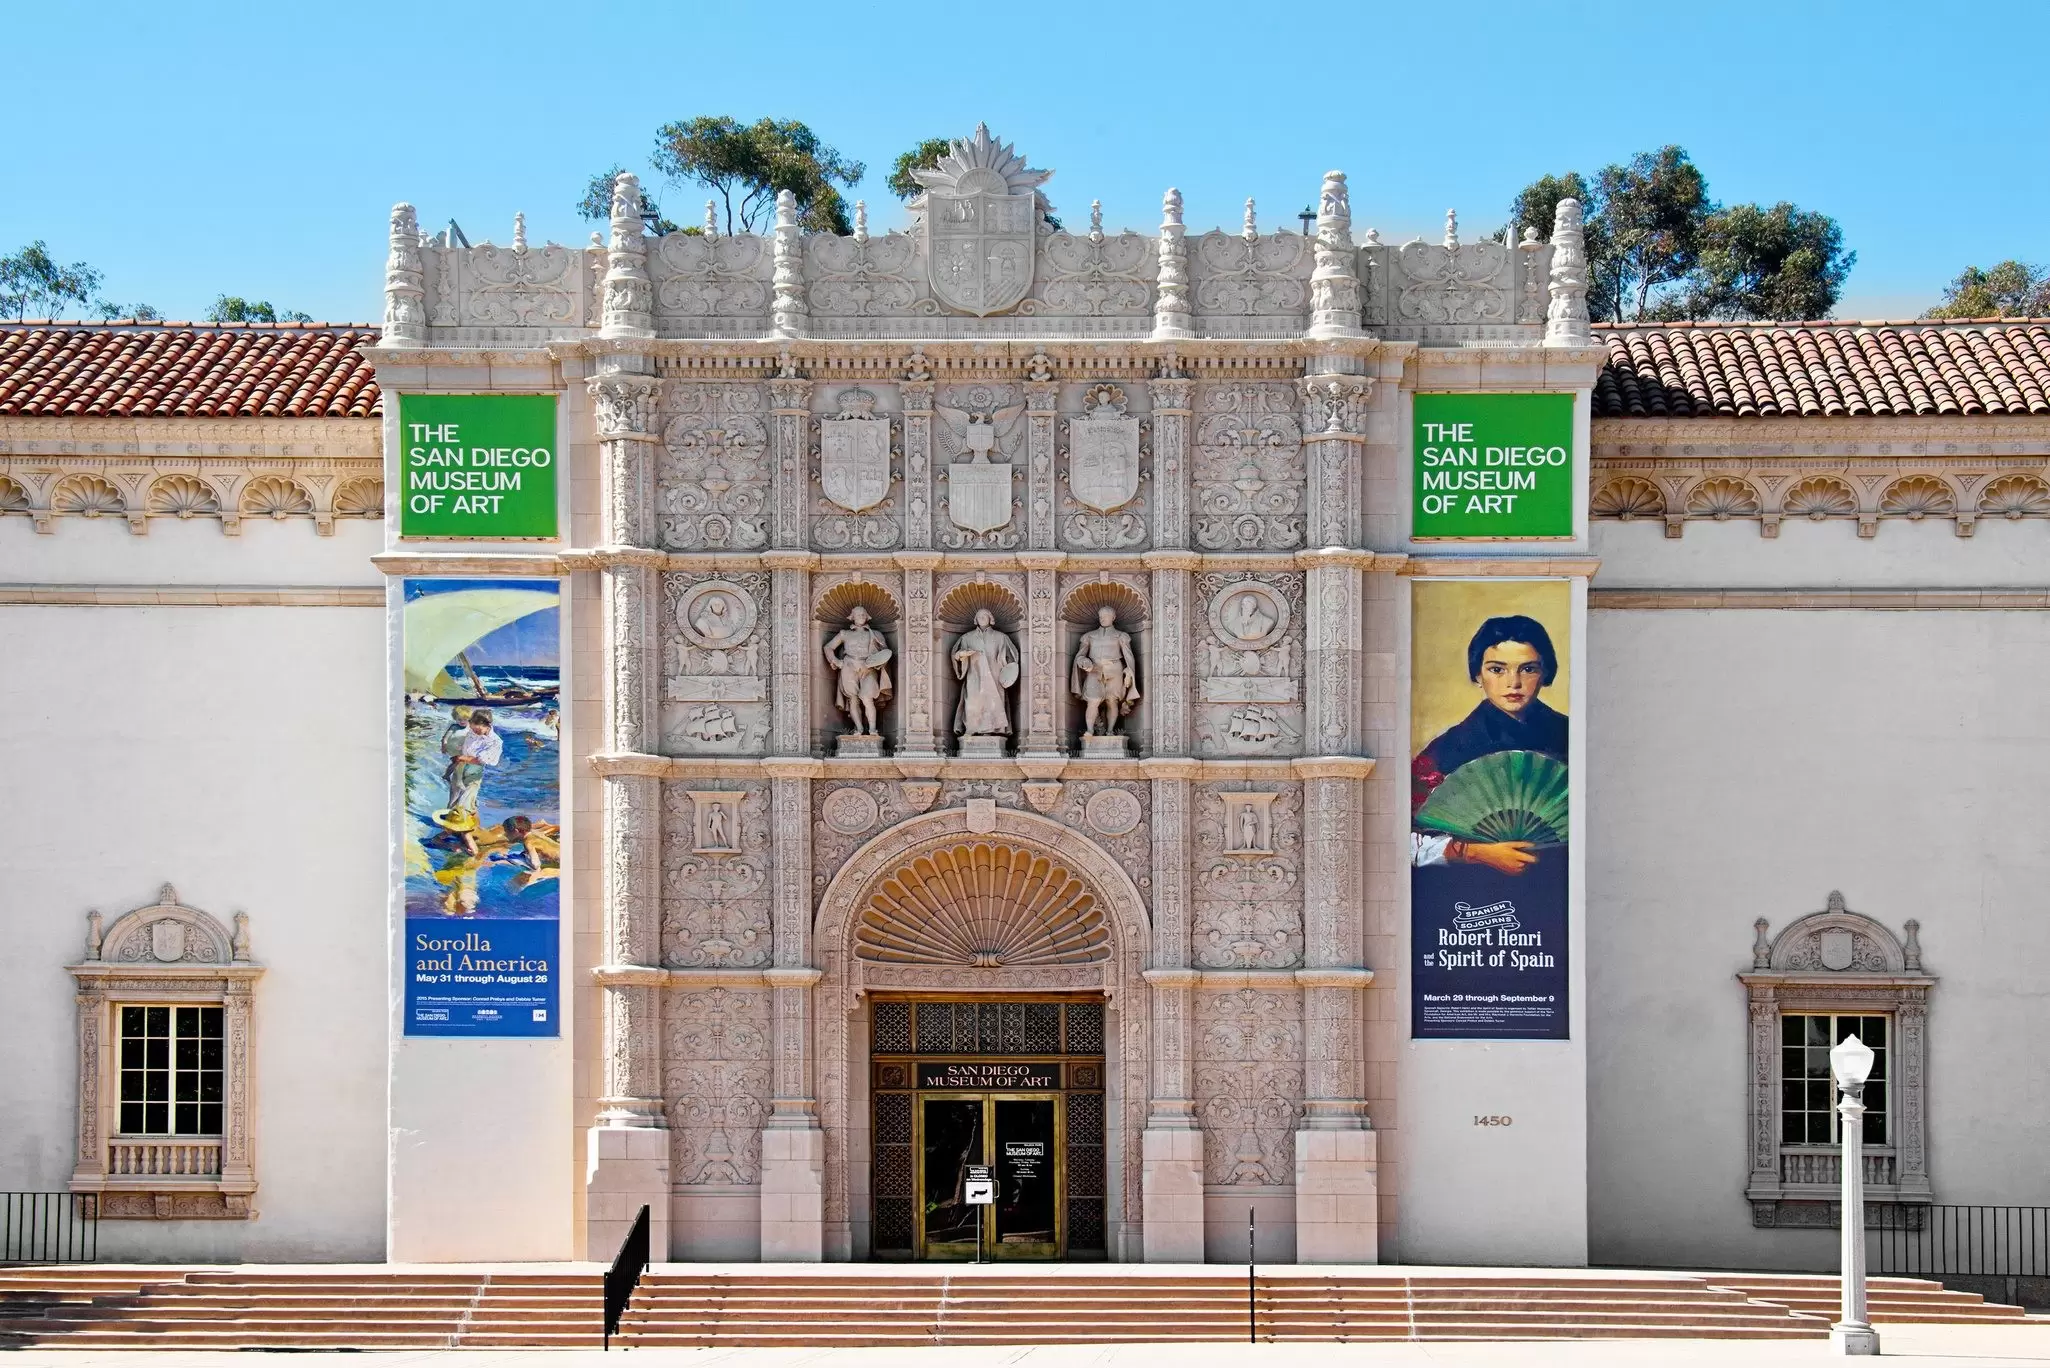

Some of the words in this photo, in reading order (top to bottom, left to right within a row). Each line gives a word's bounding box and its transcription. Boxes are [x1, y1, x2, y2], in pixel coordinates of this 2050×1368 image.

[409, 424, 460, 443] THE
[1422, 423, 1474, 443] THE
[410, 447, 464, 467] SAN
[472, 448, 551, 468] DIEGO
[1423, 447, 1478, 467] SAN
[1485, 446, 1567, 467] DIEGO
[410, 471, 521, 491] MUSEUM
[1423, 471, 1536, 491] MUSEUM
[410, 494, 446, 514] OF
[452, 495, 505, 514] ART
[1422, 494, 1459, 514] OF
[1464, 495, 1518, 514] ART
[1465, 903, 1506, 917] SPANISH
[1460, 916, 1512, 929] SOJOURNS
[416, 933, 492, 952] Sorolla
[1438, 928, 1493, 946] Robert
[1498, 928, 1542, 947] Henri
[416, 953, 453, 971] and
[457, 953, 549, 972] America
[1423, 952, 1435, 960] and
[1424, 959, 1435, 967] the
[1438, 949, 1485, 970] Spirit
[1488, 949, 1507, 967] of
[1510, 949, 1555, 971] Spain
[416, 974, 438, 984] May
[439, 974, 451, 982] 31
[454, 974, 495, 985] through
[496, 974, 533, 985] August
[534, 974, 548, 983] 26
[1452, 994, 1463, 1002] 29
[1465, 994, 1498, 1003] through
[1500, 994, 1547, 1003] September
[947, 1065, 978, 1076] SAN
[982, 1065, 1030, 1076] DIEGO
[926, 1076, 993, 1087] MUSEUM
[996, 1076, 1018, 1087] OF
[1020, 1076, 1052, 1087] ART
[1473, 1115, 1513, 1127] 1450
